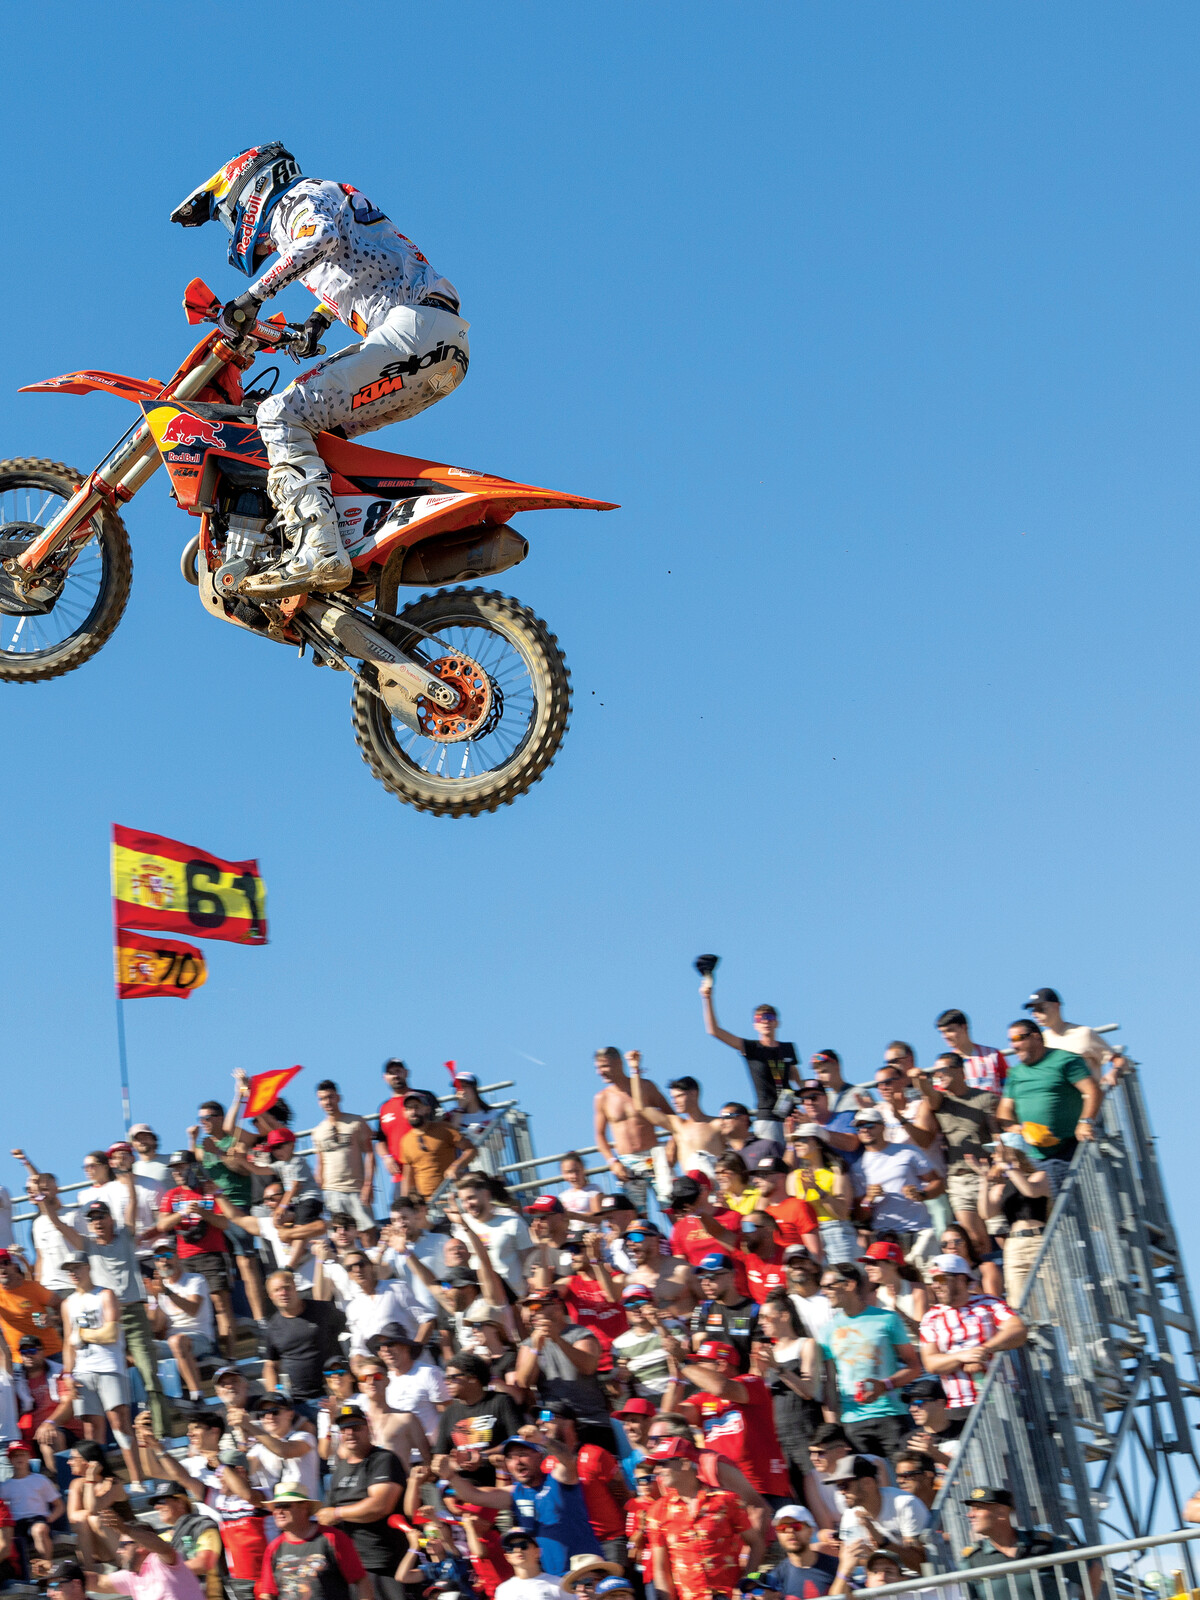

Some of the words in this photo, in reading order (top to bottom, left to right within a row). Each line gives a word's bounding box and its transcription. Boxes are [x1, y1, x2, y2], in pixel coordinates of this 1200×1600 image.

[243, 194, 262, 226] Bull
[237, 224, 254, 255] Red
[258, 324, 281, 339] RENTHAL
[351, 374, 404, 411] KTM
[168, 452, 184, 461] Red
[184, 453, 201, 463] Bull
[173, 467, 199, 478] KTM
[377, 480, 415, 488] HERLINGS
[363, 495, 421, 538] 84
[184, 859, 260, 929] 61
[156, 949, 199, 989] 70
